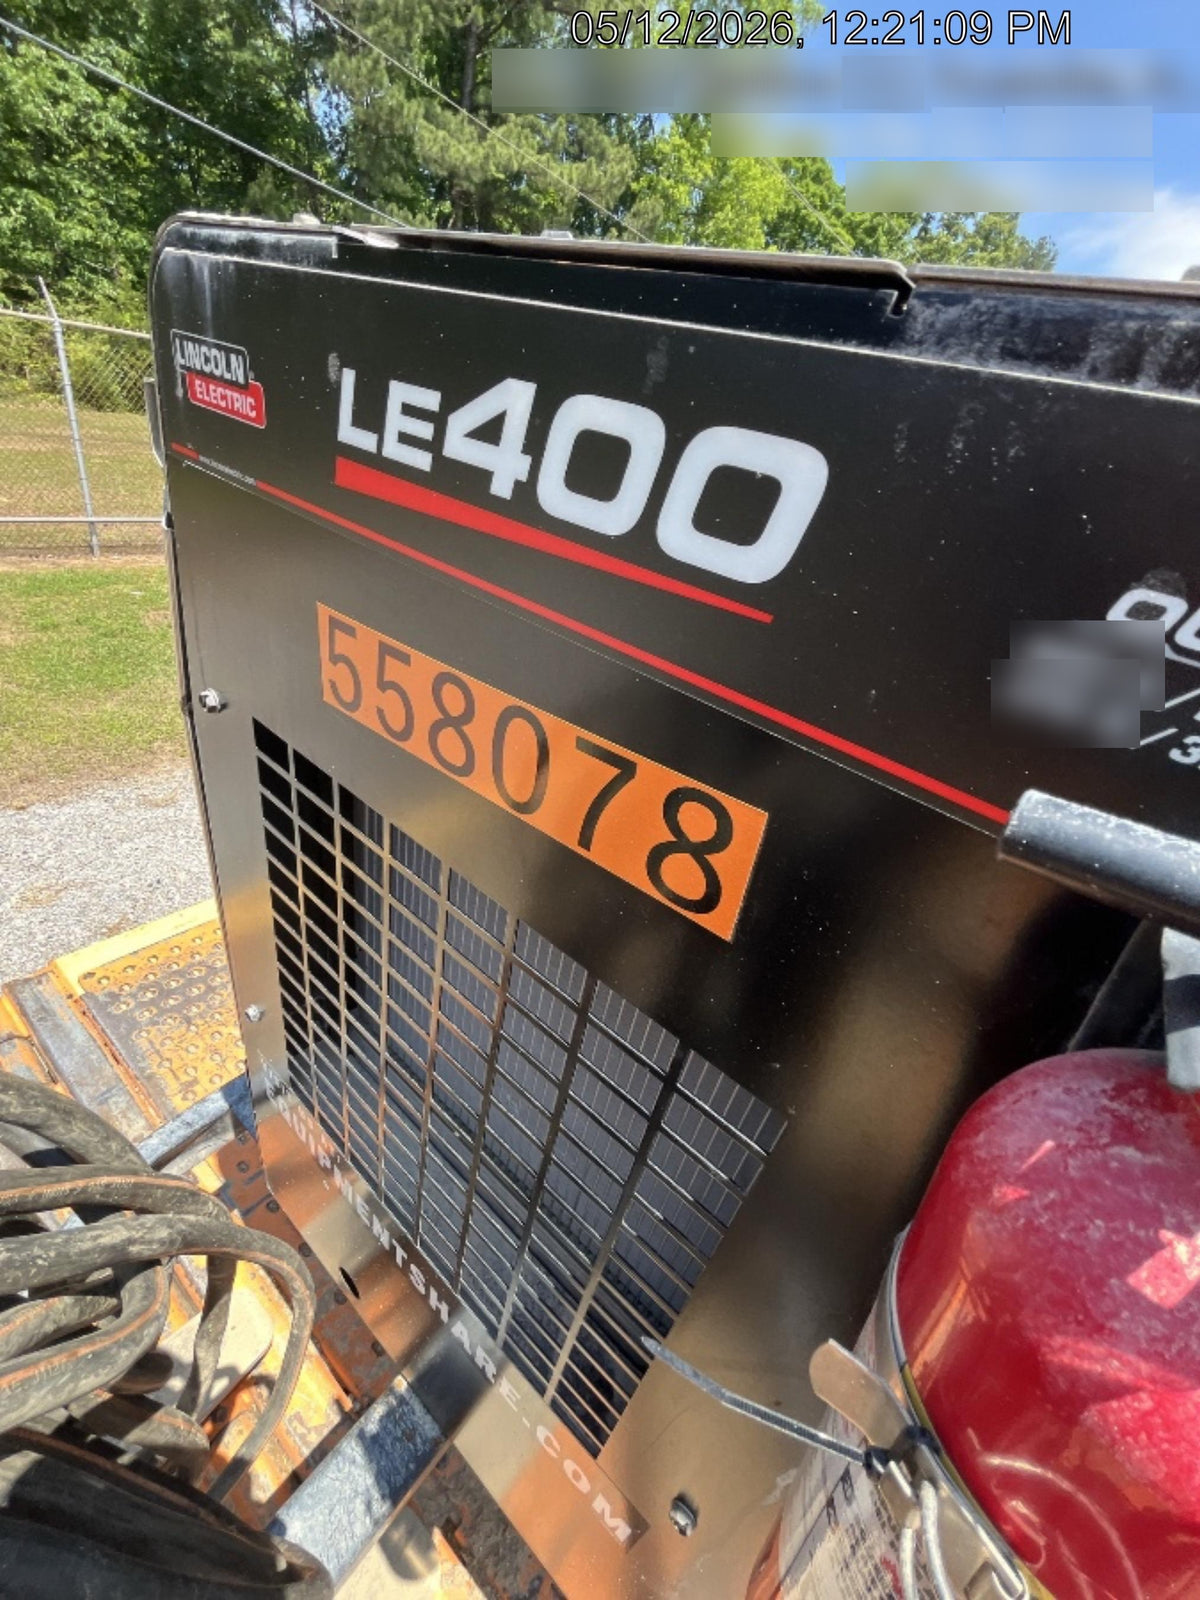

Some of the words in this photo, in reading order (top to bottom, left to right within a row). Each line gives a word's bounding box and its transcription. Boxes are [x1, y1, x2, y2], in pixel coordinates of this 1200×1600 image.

[174, 337, 245, 385] LINCOLN
[195, 380, 257, 418] ELECTRIC
[337, 367, 829, 584] LE400
[328, 615, 733, 915] 558078
